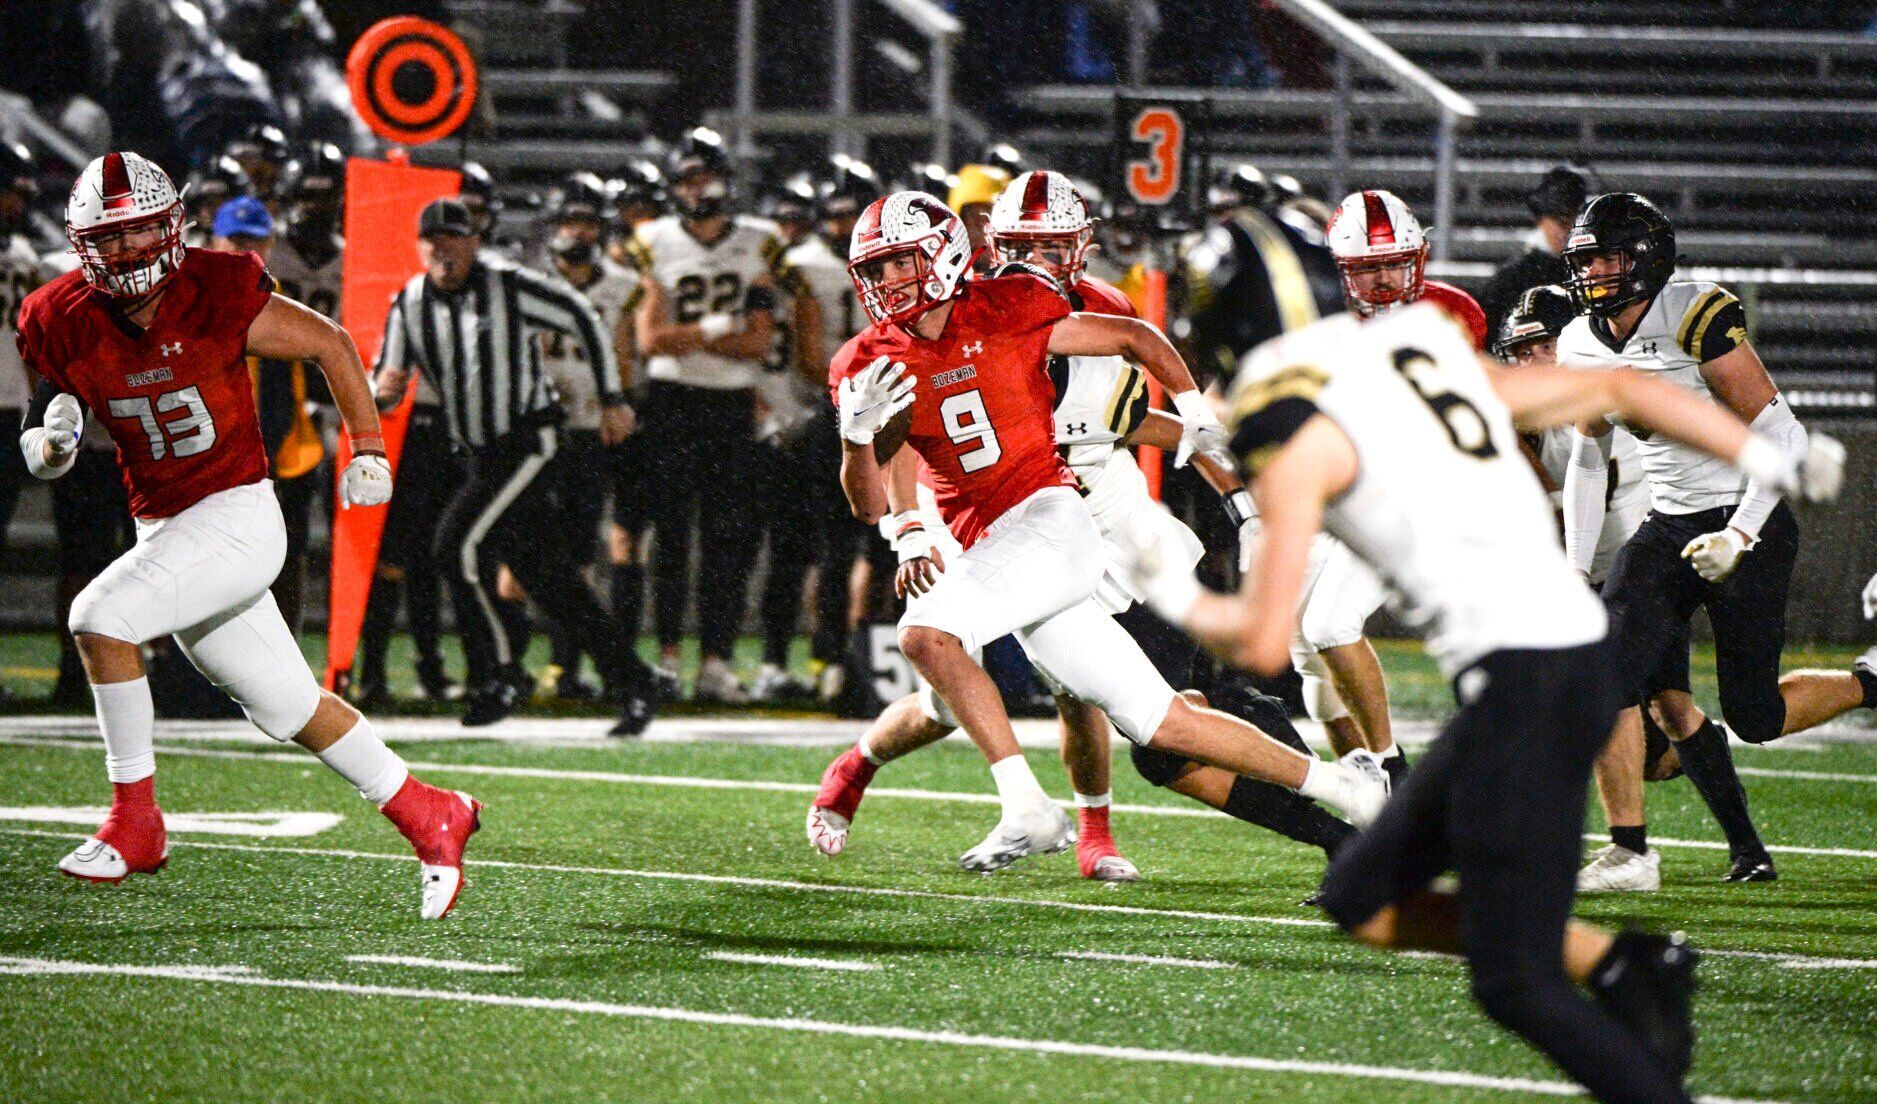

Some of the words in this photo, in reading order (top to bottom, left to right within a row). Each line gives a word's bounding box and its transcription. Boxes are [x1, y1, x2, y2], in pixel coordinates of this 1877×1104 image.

[1126, 106, 1184, 205] 3
[676, 273, 742, 322] 22
[126, 366, 174, 388] BOZEMAN
[931, 363, 977, 389] BOZEMAN
[1390, 346, 1499, 459] 6
[107, 384, 217, 461] 73
[939, 387, 1003, 475] 9
